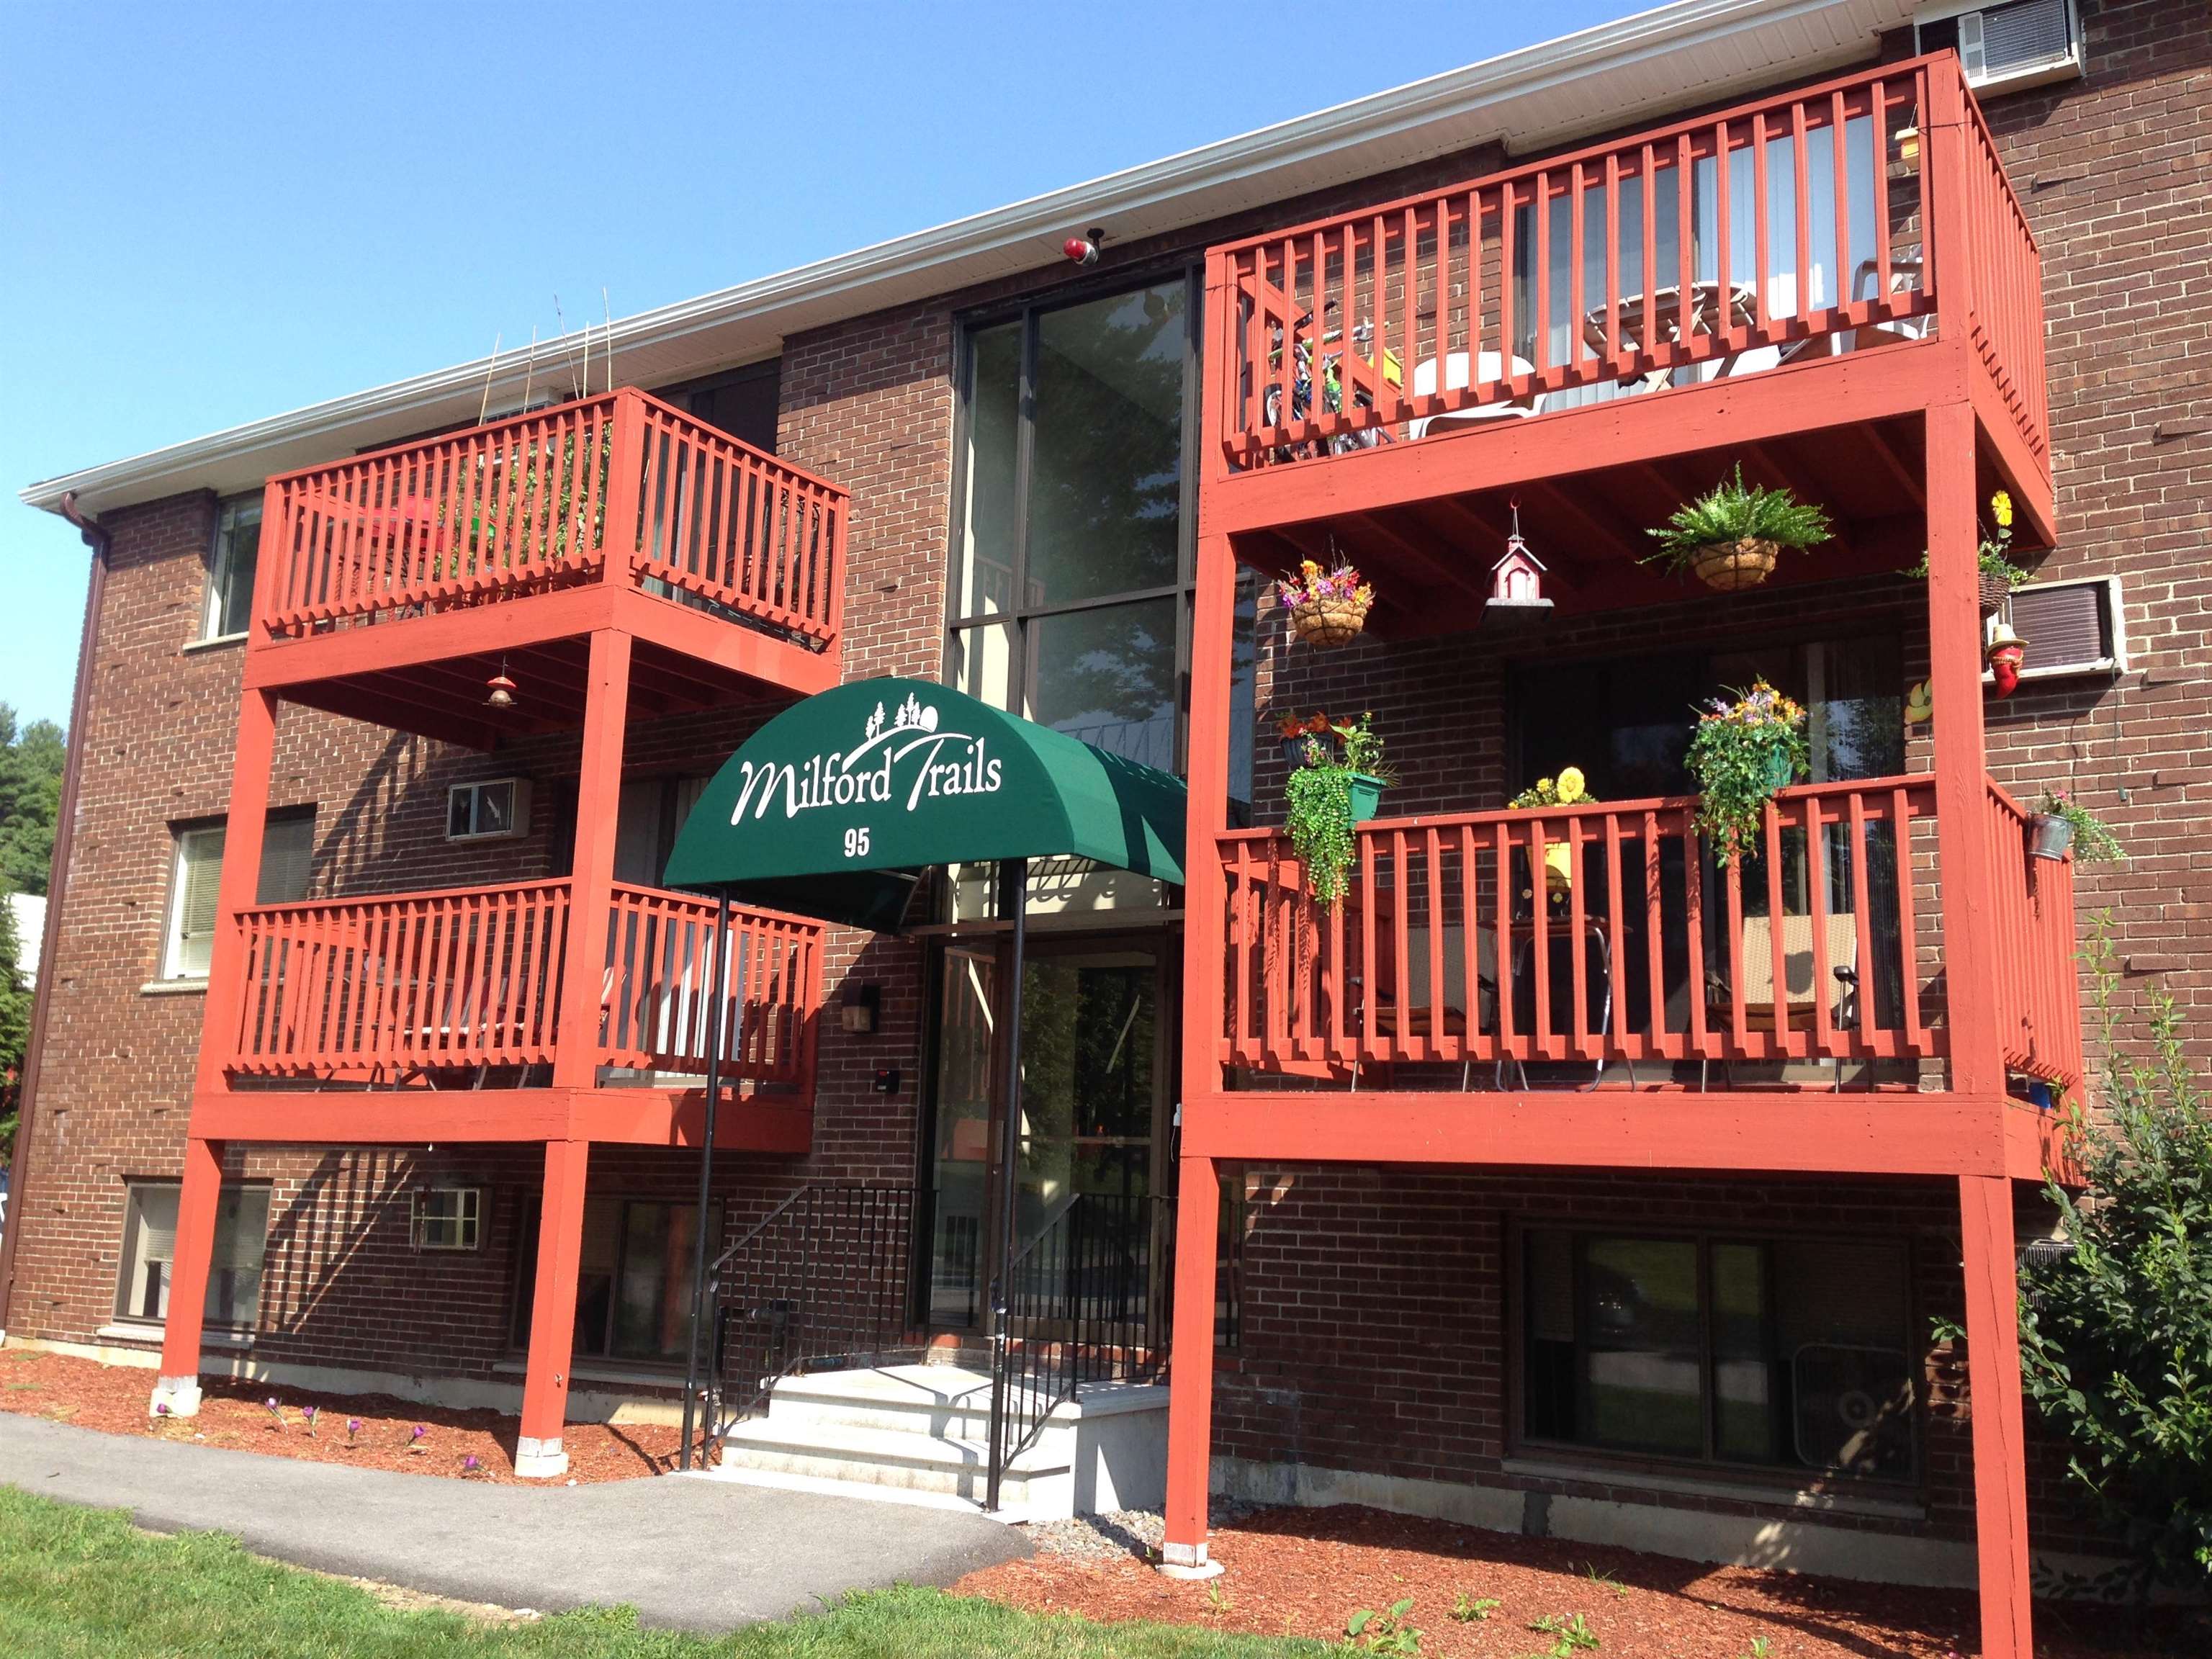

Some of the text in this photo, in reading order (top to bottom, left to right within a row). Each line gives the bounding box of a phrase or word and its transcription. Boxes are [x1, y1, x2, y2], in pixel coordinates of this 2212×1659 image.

[730, 732, 1002, 826] Milford Trails
[844, 827, 870, 858] 95
